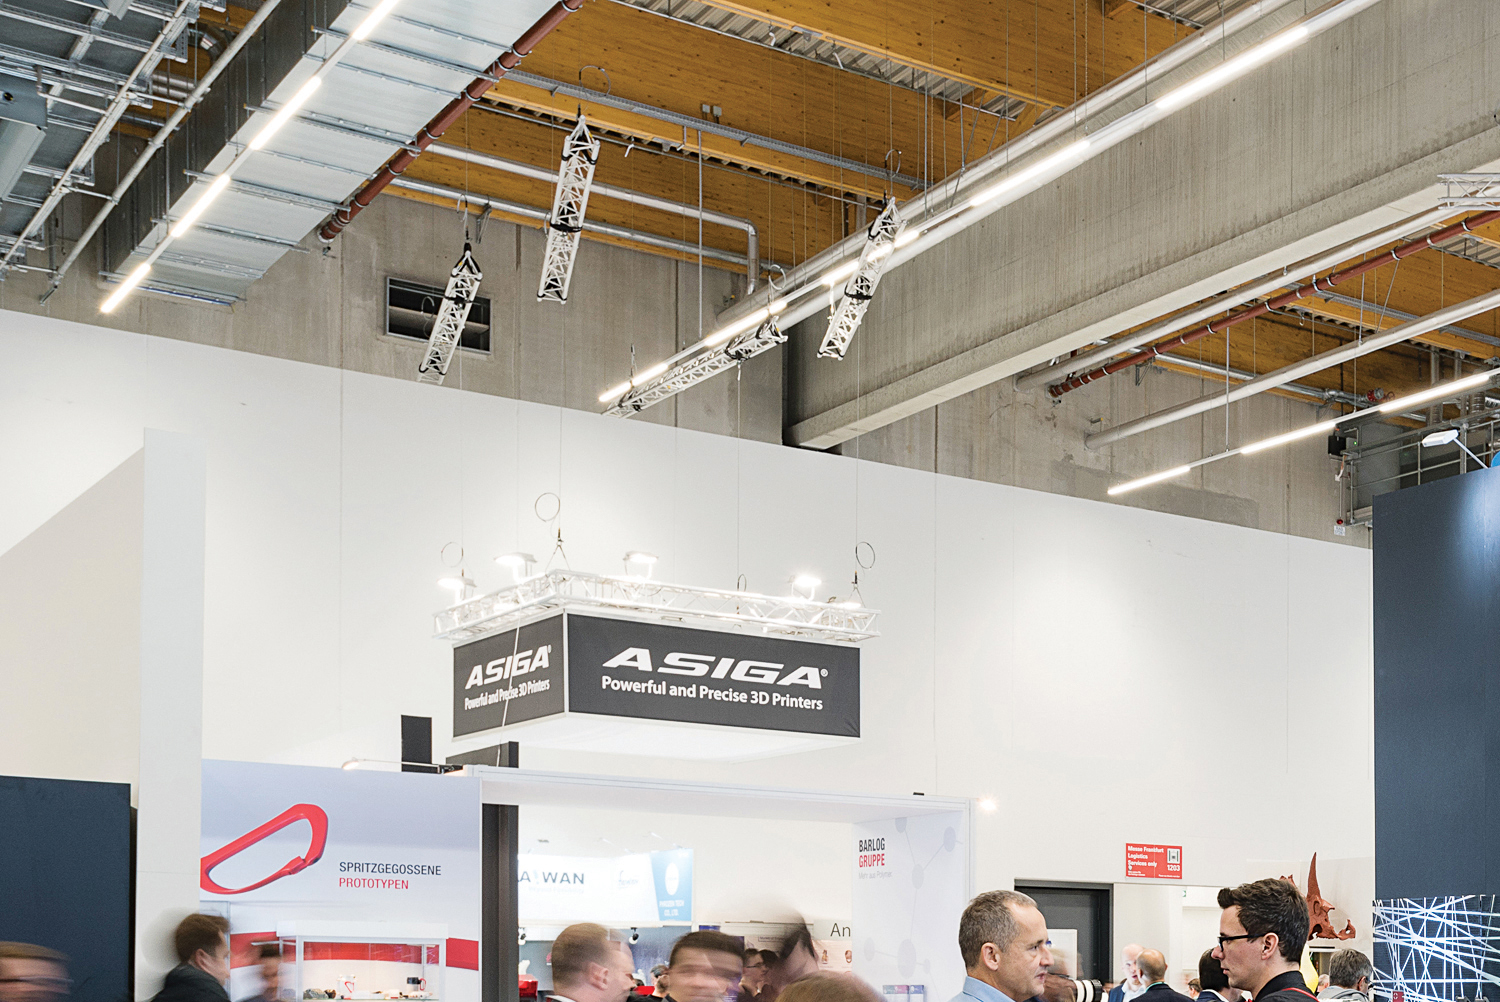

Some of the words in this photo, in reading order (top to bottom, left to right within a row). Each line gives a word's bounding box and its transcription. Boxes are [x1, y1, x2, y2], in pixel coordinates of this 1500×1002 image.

[464, 691, 489, 711] Powerful
[488, 688, 499, 705] and
[499, 685, 519, 702] Precise
[518, 683, 527, 698] 3D
[527, 679, 550, 695] Printers
[601, 675, 667, 696] Powerful
[668, 683, 697, 699] and
[699, 685, 748, 704] Precise
[750, 691, 770, 706] 3D
[772, 693, 824, 711] Printers
[858, 837, 886, 852] BARLOG
[858, 853, 886, 868] GRUPPE
[339, 861, 442, 876] SPRITZGEGOSSENE
[338, 877, 409, 890] PROTOTYPEN
